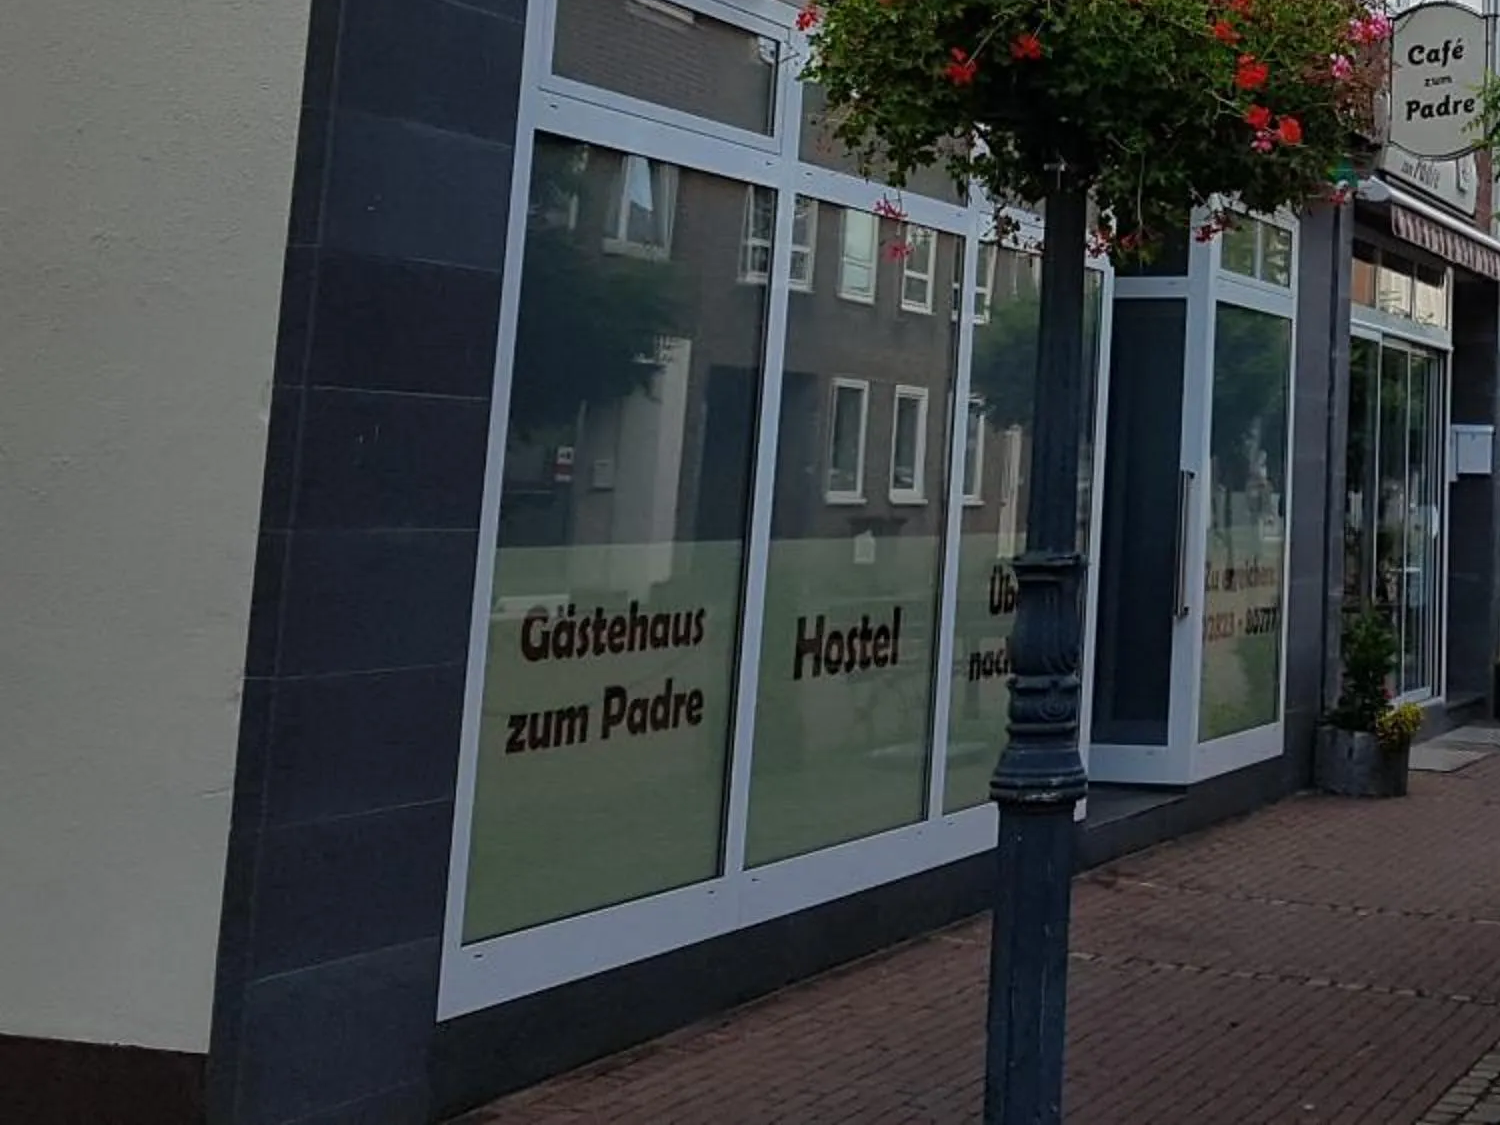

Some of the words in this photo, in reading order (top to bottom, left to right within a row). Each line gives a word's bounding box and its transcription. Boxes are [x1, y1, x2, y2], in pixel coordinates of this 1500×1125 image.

[1407, 36, 1465, 67] Café
[1424, 76, 1453, 88] zum
[1406, 95, 1475, 121] Padre
[520, 600, 706, 662] Gästehaus
[792, 607, 902, 680] Hostel
[505, 704, 590, 755] zum
[601, 677, 705, 740] Padre
